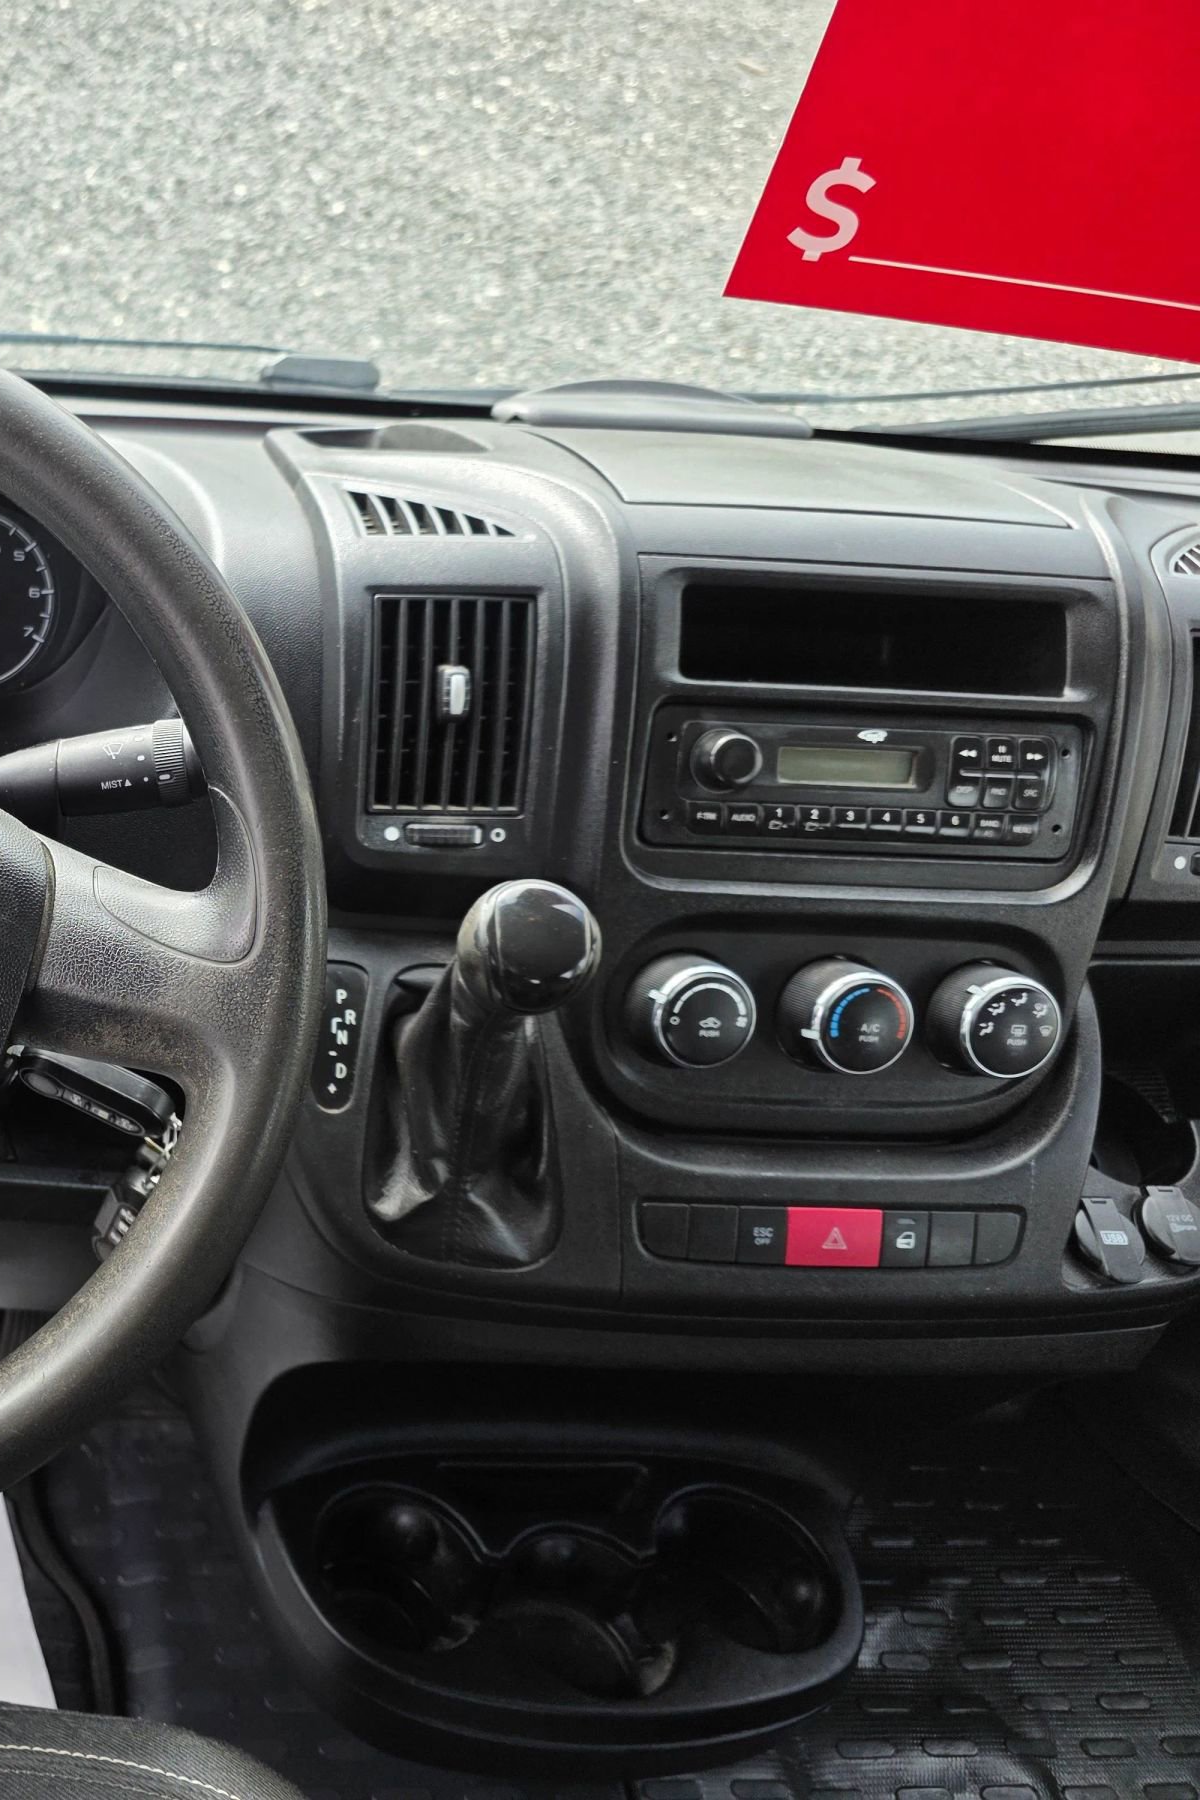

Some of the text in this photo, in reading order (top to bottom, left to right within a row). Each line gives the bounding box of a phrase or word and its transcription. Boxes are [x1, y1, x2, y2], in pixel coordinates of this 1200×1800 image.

[786, 157, 877, 262] $
[13, 550, 25, 561] 5
[28, 587, 40, 598] 6
[23, 626, 35, 637] 7
[101, 779, 123, 790] MIST
[776, 808, 782, 818] 1
[810, 808, 820, 820] 2
[846, 810, 855, 821] 3
[881, 812, 891, 823] 4
[916, 813, 925, 824] 5
[951, 815, 960, 826] 6
[336, 988, 348, 1005] P
[344, 1009, 356, 1025] R
[860, 1023, 880, 1033] A/C
[336, 1030, 348, 1045] N
[335, 1062, 347, 1079] D
[753, 1226, 774, 1237] ESC
[1103, 1232, 1123, 1243] USB
